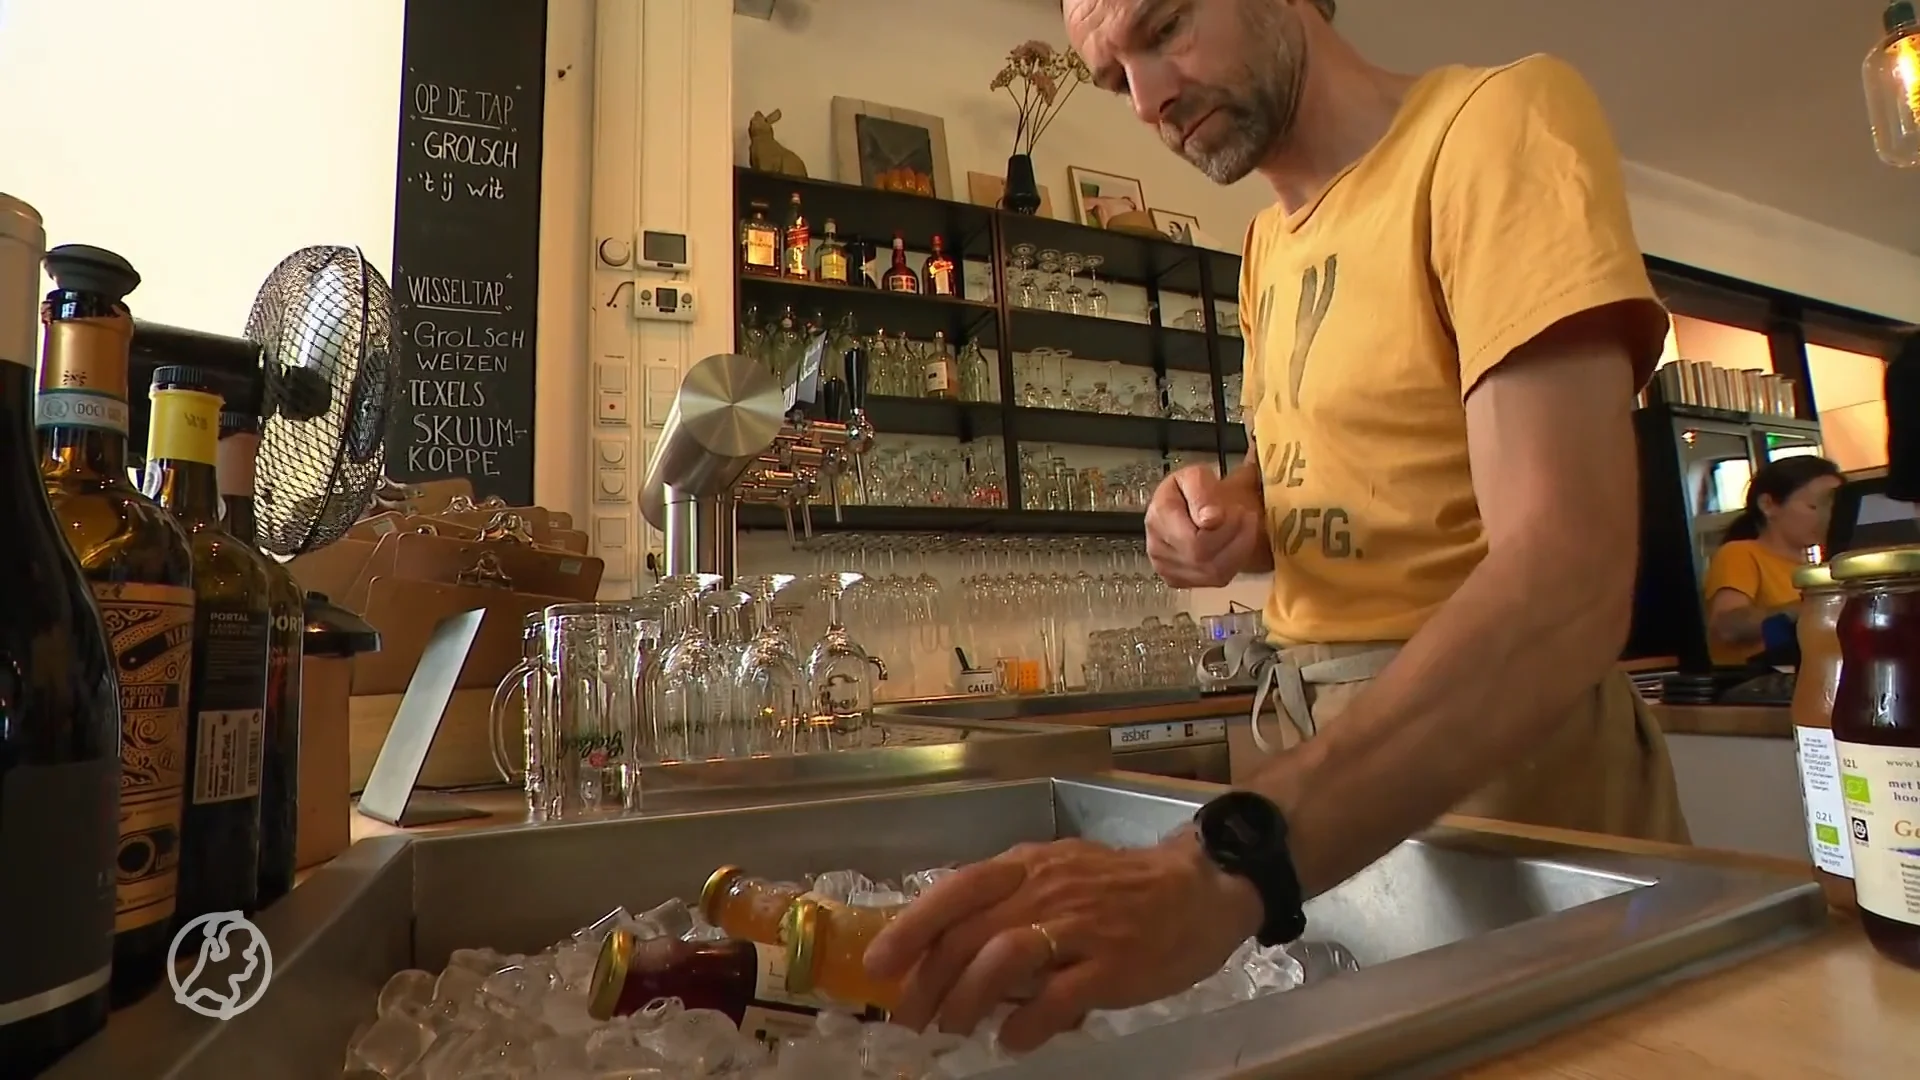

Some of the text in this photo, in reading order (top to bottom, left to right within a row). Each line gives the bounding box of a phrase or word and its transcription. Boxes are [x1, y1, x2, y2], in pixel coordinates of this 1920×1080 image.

[415, 83, 514, 125] OP DE TAP
[424, 131, 518, 169] GROLSCH
[467, 176, 504, 199] wit
[408, 379, 485, 408] TEXELS
[408, 446, 501, 475] KOPPE
[210, 612, 250, 622] PORTAL
[137, 695, 166, 709] ITALY
[1121, 728, 1152, 742] asber
[1888, 780, 1913, 790] met
[1893, 791, 1920, 804] hoo
